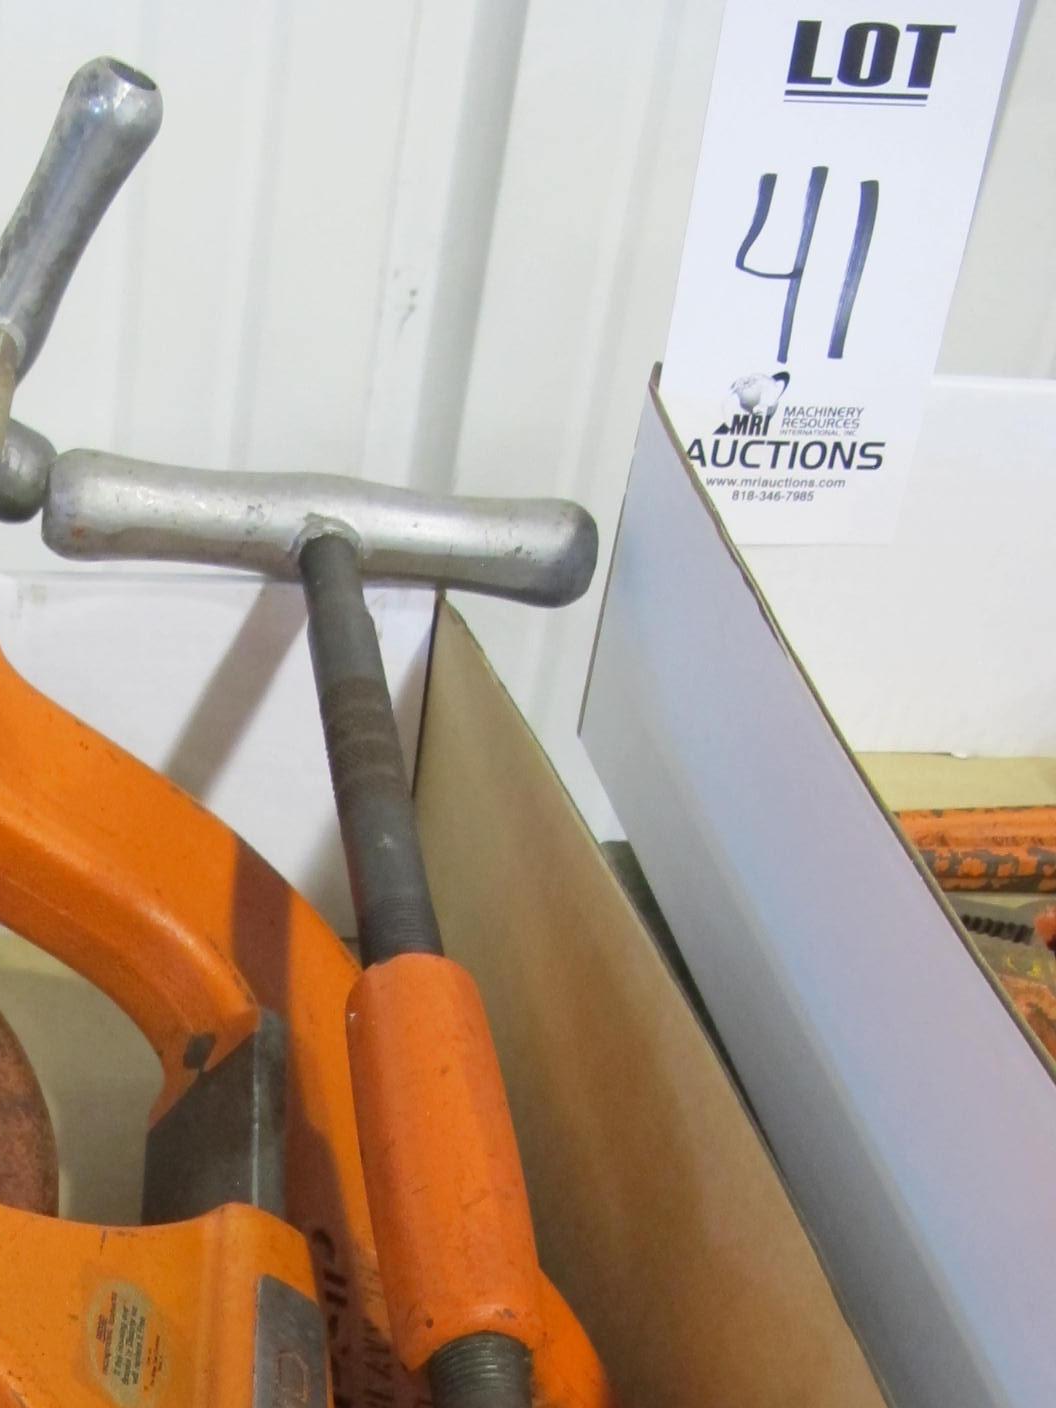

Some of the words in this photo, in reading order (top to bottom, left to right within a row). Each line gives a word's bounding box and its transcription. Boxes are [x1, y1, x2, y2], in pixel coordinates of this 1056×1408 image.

[787, 20, 957, 90] LOT
[735, 166, 879, 364] 41
[783, 406, 865, 418] MACHINERY
[728, 414, 772, 437] MRI
[780, 417, 861, 430] RESOURCES
[686, 438, 886, 471] AUCTIONS
[705, 476, 846, 489] www.mriauctions.com
[731, 490, 815, 502] 818-346-7985
